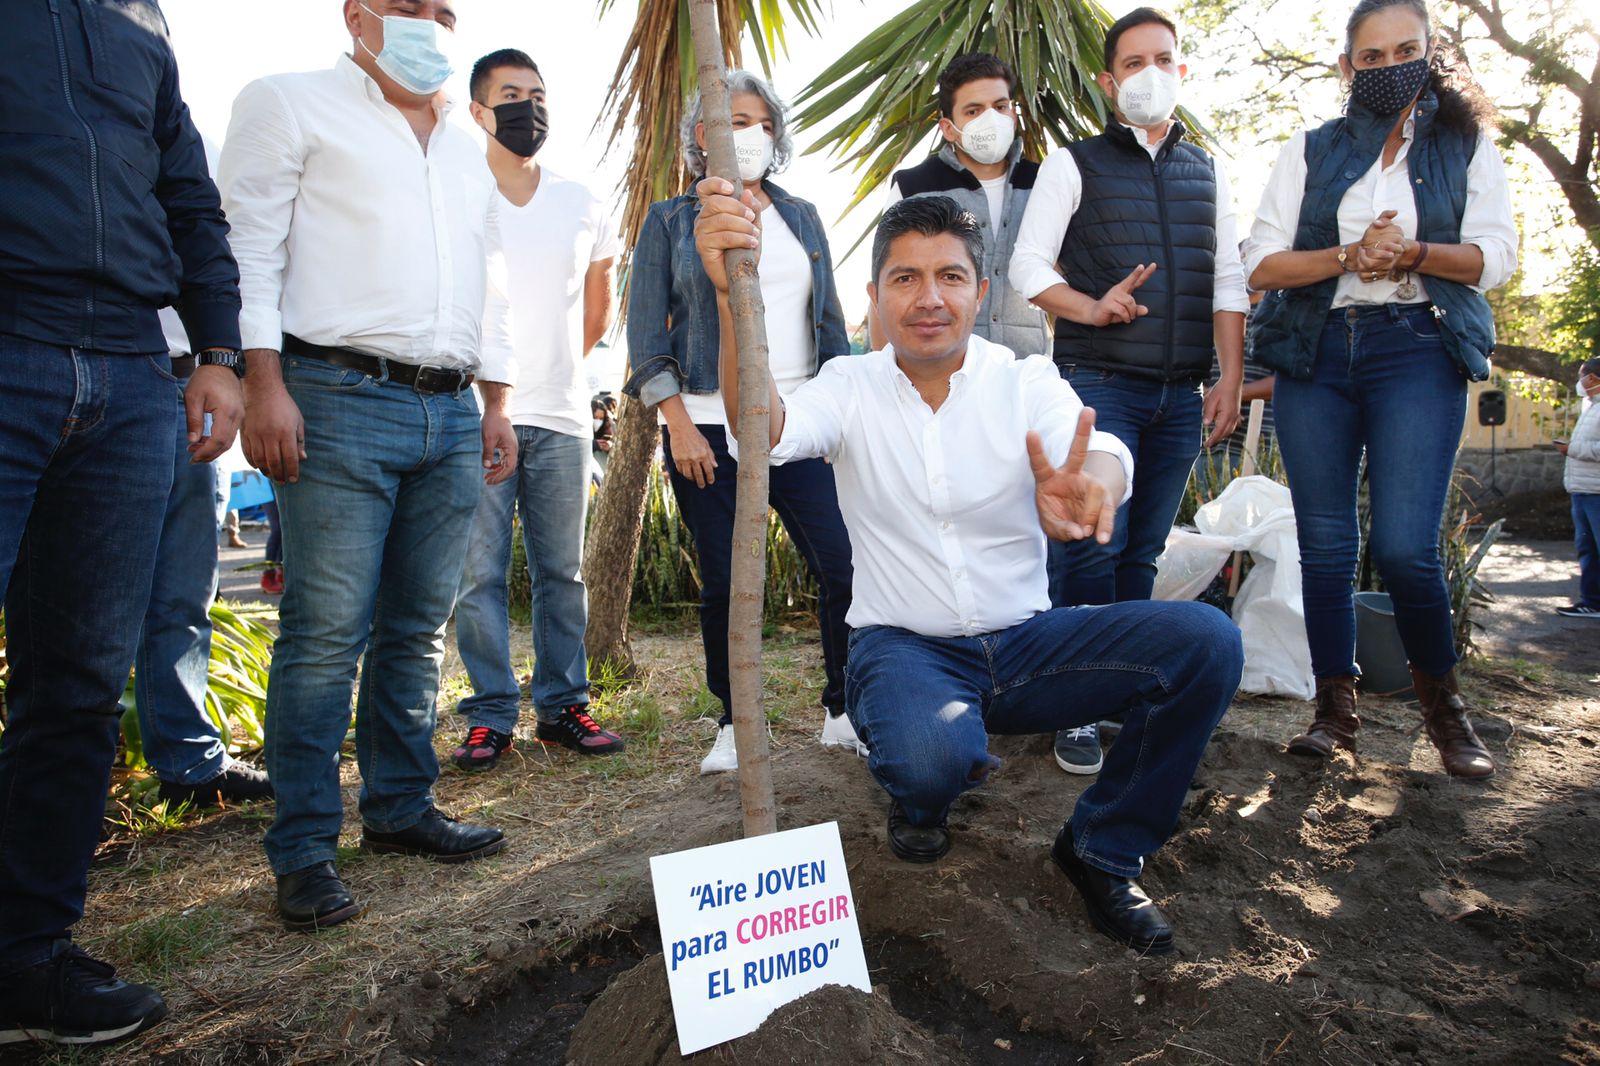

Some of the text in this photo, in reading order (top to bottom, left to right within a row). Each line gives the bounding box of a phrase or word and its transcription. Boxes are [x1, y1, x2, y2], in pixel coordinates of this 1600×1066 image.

[691, 860, 826, 911] “Aire JOVEN
[671, 895, 849, 971] para CORREGIR
[708, 938, 838, 999] EL RUMBO”
